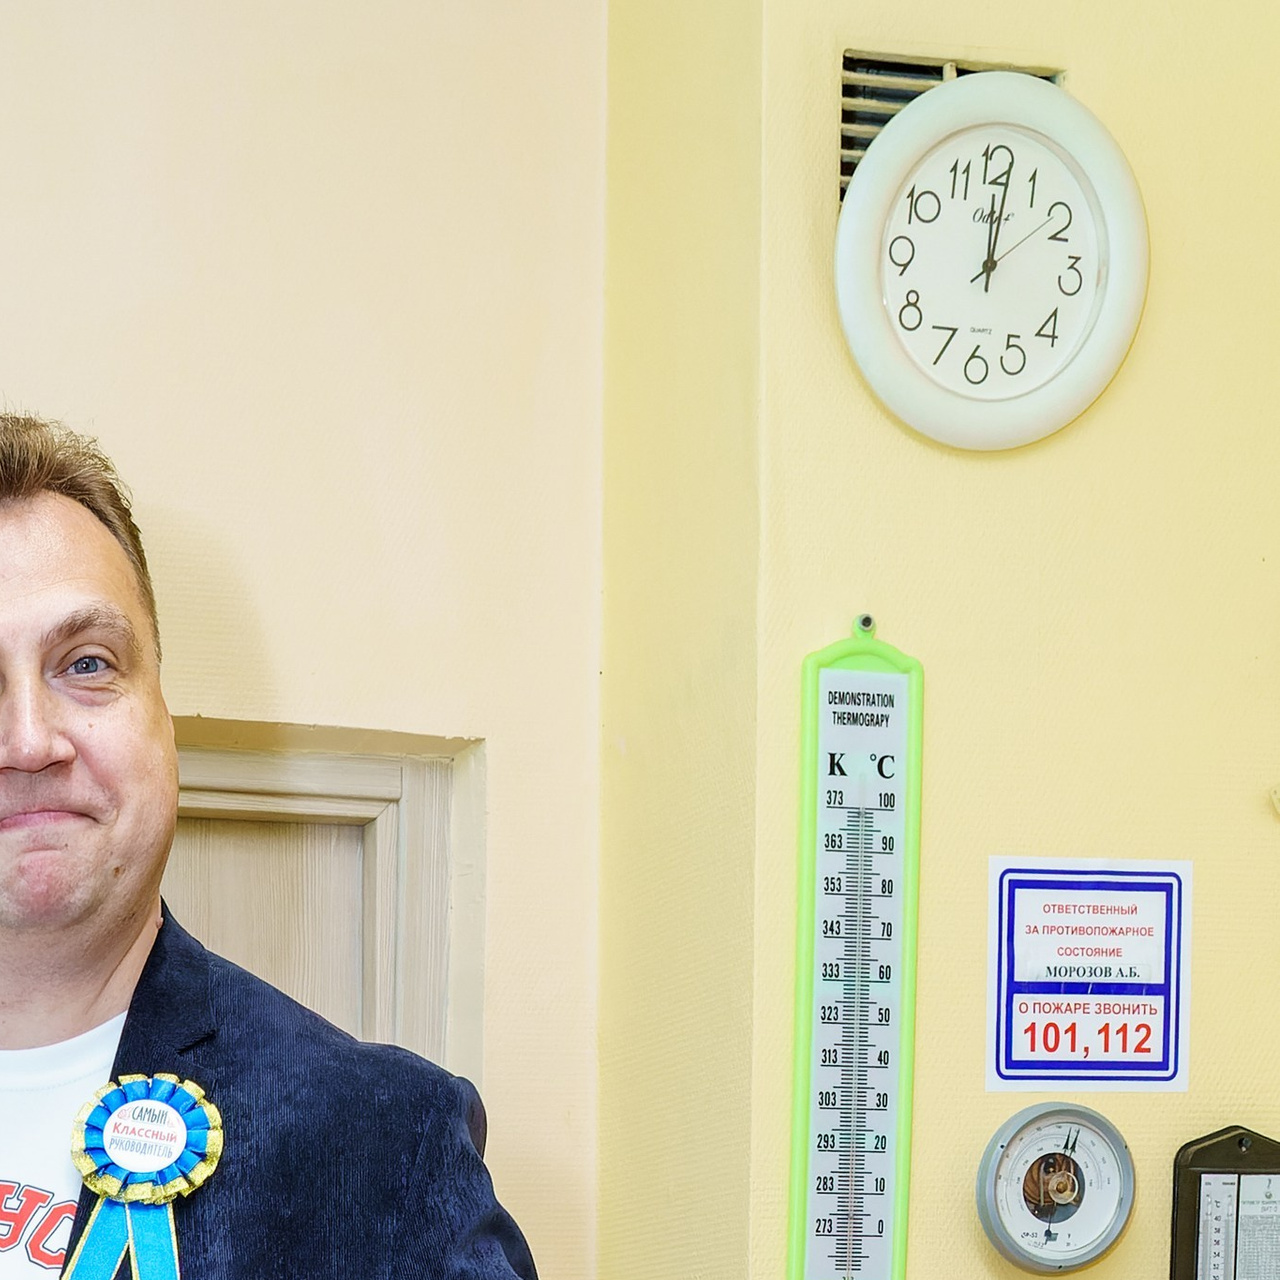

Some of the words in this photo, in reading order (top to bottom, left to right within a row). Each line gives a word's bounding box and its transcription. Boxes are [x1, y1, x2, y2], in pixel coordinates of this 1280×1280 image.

[982, 143, 1014, 186] 12
[949, 158, 971, 200] 11
[1028, 167, 1038, 208] 1
[907, 184, 941, 225] 10
[1048, 202, 1072, 242] 2
[889, 235, 915, 276] 9
[1057, 255, 1082, 296] 3
[899, 290, 922, 331] 8
[1034, 306, 1059, 347] 4
[932, 325, 958, 365] 7
[1000, 334, 1026, 375] 5
[964, 345, 988, 384] 6
[828, 690, 895, 708] DEMONSTRATION
[832, 711, 890, 728] THERMOGRAPY
[827, 752, 847, 777] K
[870, 753, 895, 779] °C
[826, 790, 844, 806] 373
[878, 793, 895, 808] 100
[824, 834, 843, 849] 363
[881, 836, 895, 851] 90
[823, 877, 842, 892] 353
[881, 880, 893, 894] 80
[1042, 903, 1138, 916] ОТВЕТСТВЕННЫЙ
[822, 920, 841, 935] 343
[880, 922, 892, 937] 70
[1025, 925, 1039, 935] ЗА
[1042, 925, 1155, 937] ПРОТИВОПОЖАРНОЕ
[1057, 947, 1123, 958] СОСТОЯНИЕ
[822, 963, 840, 978] 333
[878, 965, 891, 980] 60
[1045, 965, 1112, 978] МОРОЗОВ
[1115, 966, 1141, 979] А.Б.
[820, 1006, 839, 1022] 323
[878, 1008, 890, 1023] 50
[1018, 1002, 1029, 1014] О
[1033, 1002, 1091, 1015] ПОЖАРЕ
[1094, 1003, 1158, 1016] ЗВОНИТЬ
[821, 1049, 838, 1064] 313
[877, 1050, 889, 1066] 40
[818, 1092, 837, 1107] 303
[876, 1093, 888, 1108] 30
[108, 1138, 173, 1159] РУКОВОДИТЕЛЬ
[817, 1134, 836, 1149] 293
[874, 1135, 887, 1150] 20
[816, 1177, 834, 1191] 283
[874, 1178, 885, 1192] 10
[815, 1219, 833, 1234] 273
[877, 1220, 884, 1234] 0
